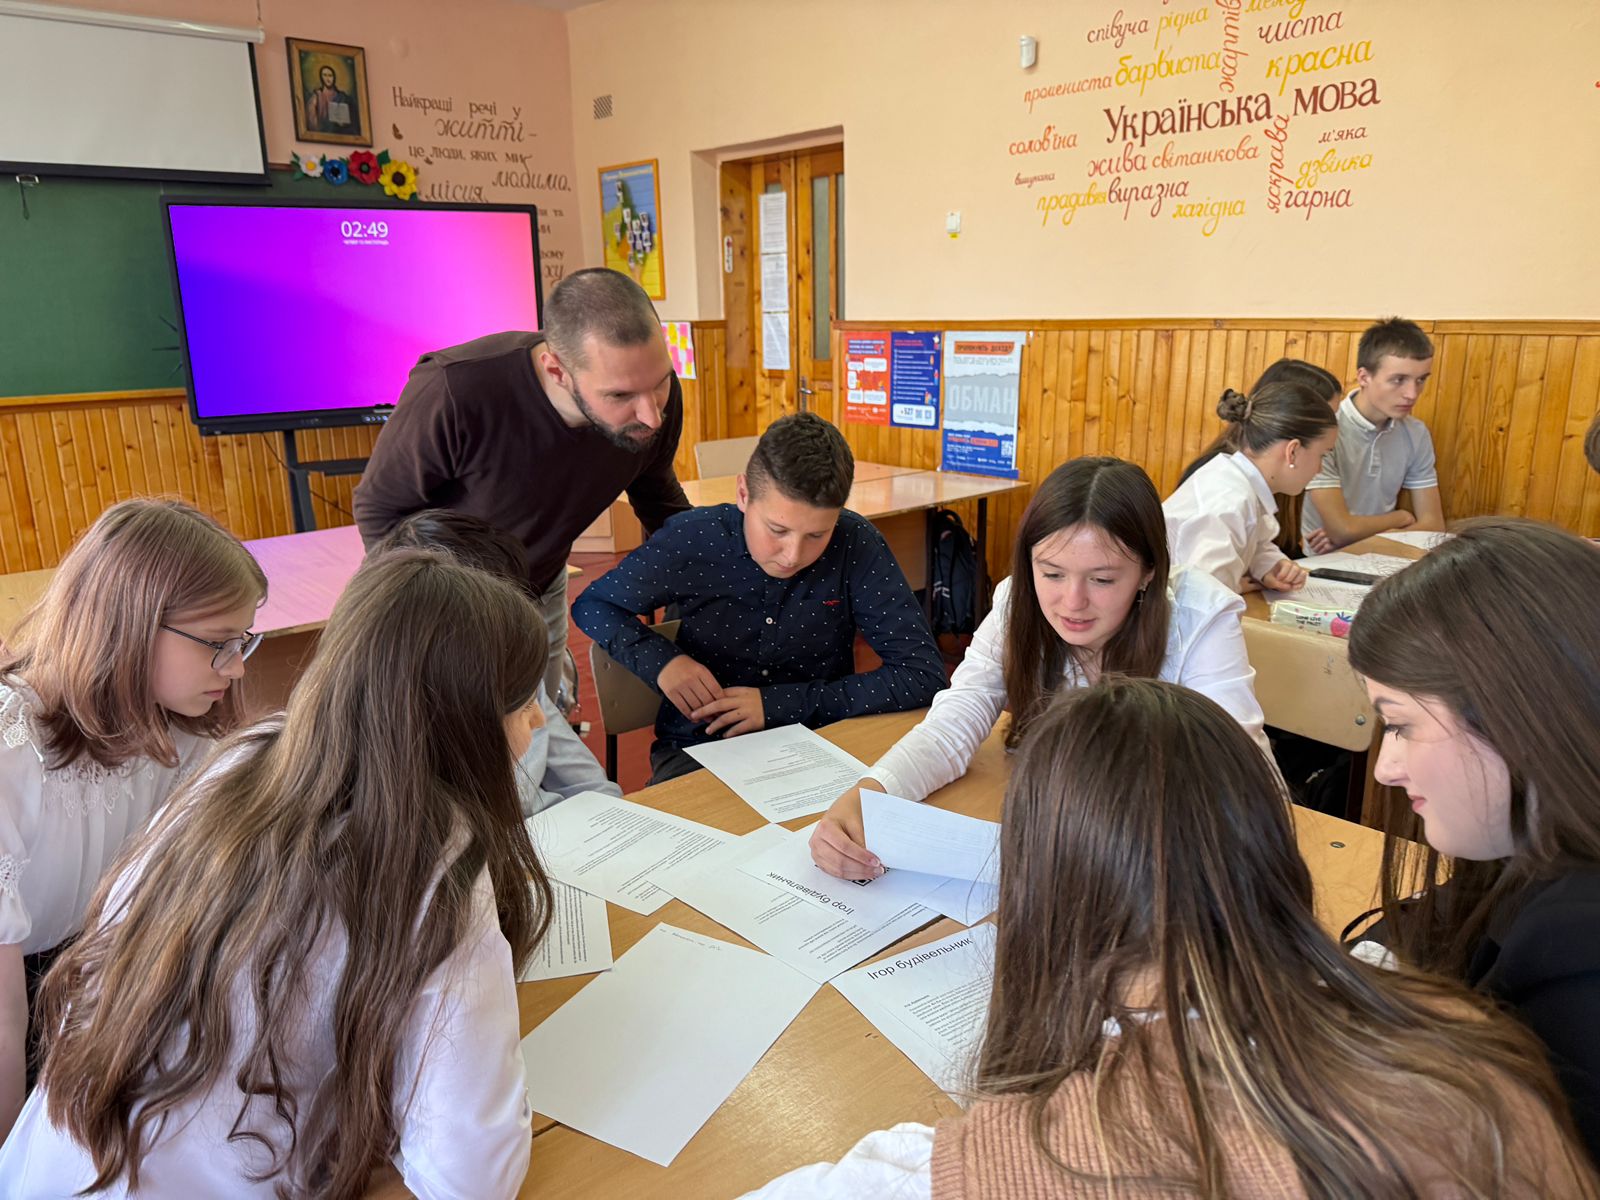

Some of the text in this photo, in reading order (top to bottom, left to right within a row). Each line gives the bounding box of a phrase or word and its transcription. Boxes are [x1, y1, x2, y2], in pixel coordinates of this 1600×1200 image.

[1087, 9, 1150, 49] співуча
[1153, 7, 1210, 50] рідна
[1258, 11, 1344, 44] чиста
[1265, 40, 1375, 97] красна
[391, 86, 453, 116] Найкращі
[468, 101, 497, 119] речі
[1102, 77, 1382, 148] Українська мова
[434, 118, 526, 143] житті
[408, 145, 425, 158] це
[470, 149, 498, 162] яких
[1087, 141, 1147, 178] жива
[1151, 134, 1260, 169] світанкова
[1263, 114, 1294, 214] яскрава
[1295, 148, 1375, 190] дзвінка
[1108, 176, 1190, 220] виразна
[1172, 195, 1247, 237] лагідна
[1284, 188, 1354, 221] гарна
[340, 220, 389, 238] 02:49
[948, 384, 1015, 416] ОБМАН
[766, 871, 831, 904] будівельник
[831, 900, 855, 915] Ігор
[866, 965, 895, 980] Ігор
[895, 937, 974, 969] будівельник
